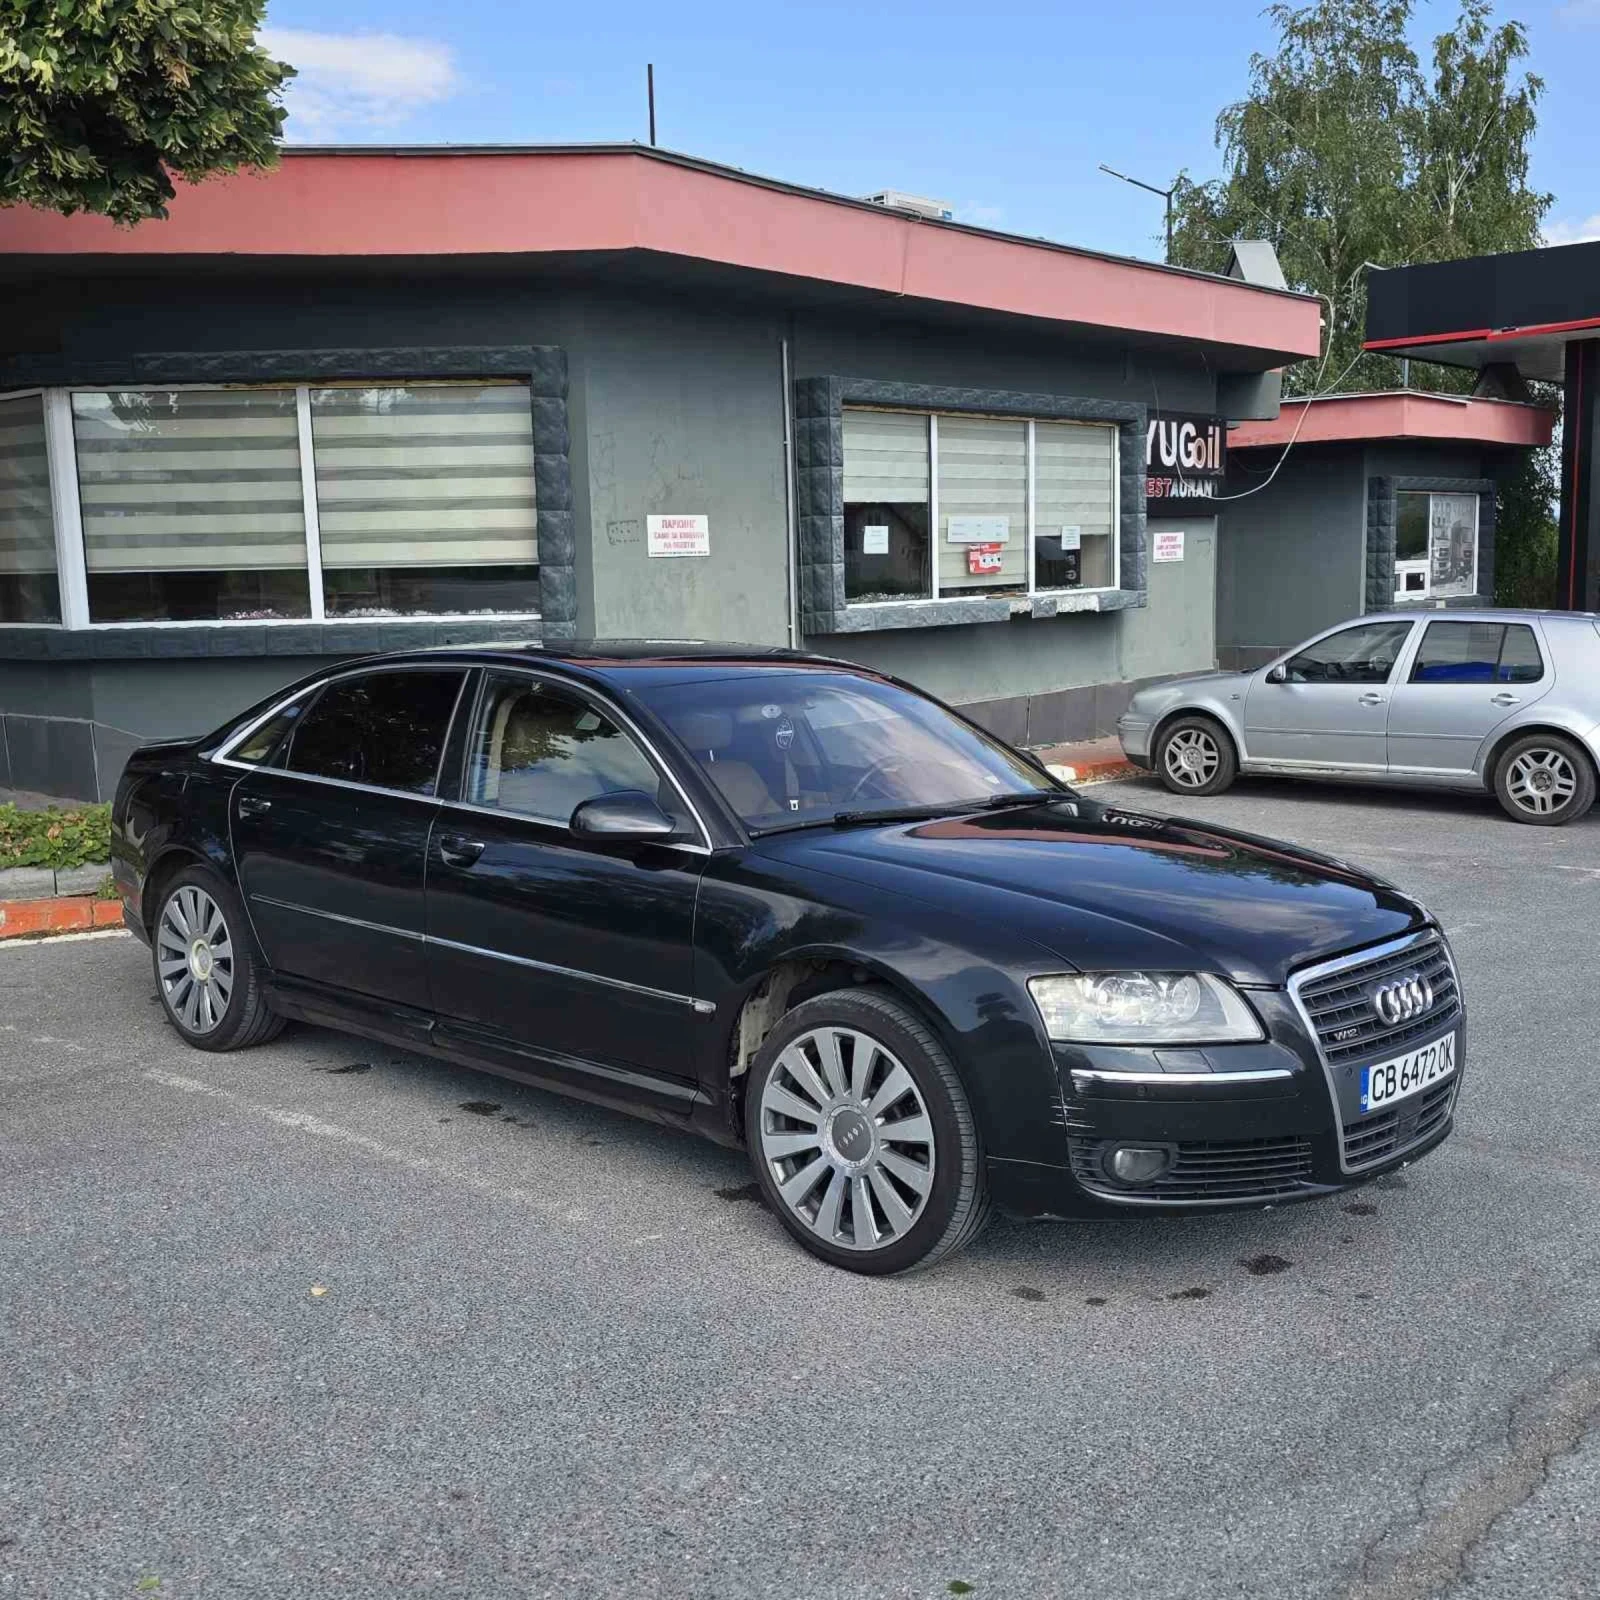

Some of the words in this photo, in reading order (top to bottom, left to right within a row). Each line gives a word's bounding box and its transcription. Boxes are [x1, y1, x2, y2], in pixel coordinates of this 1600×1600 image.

[1146, 478, 1218, 498] ESTAURANT
[1333, 1028, 1359, 1041] W12
[1372, 1065, 1397, 1102] CB
[1400, 1048, 1437, 1091] 6472
[1437, 1038, 1454, 1073] OK
